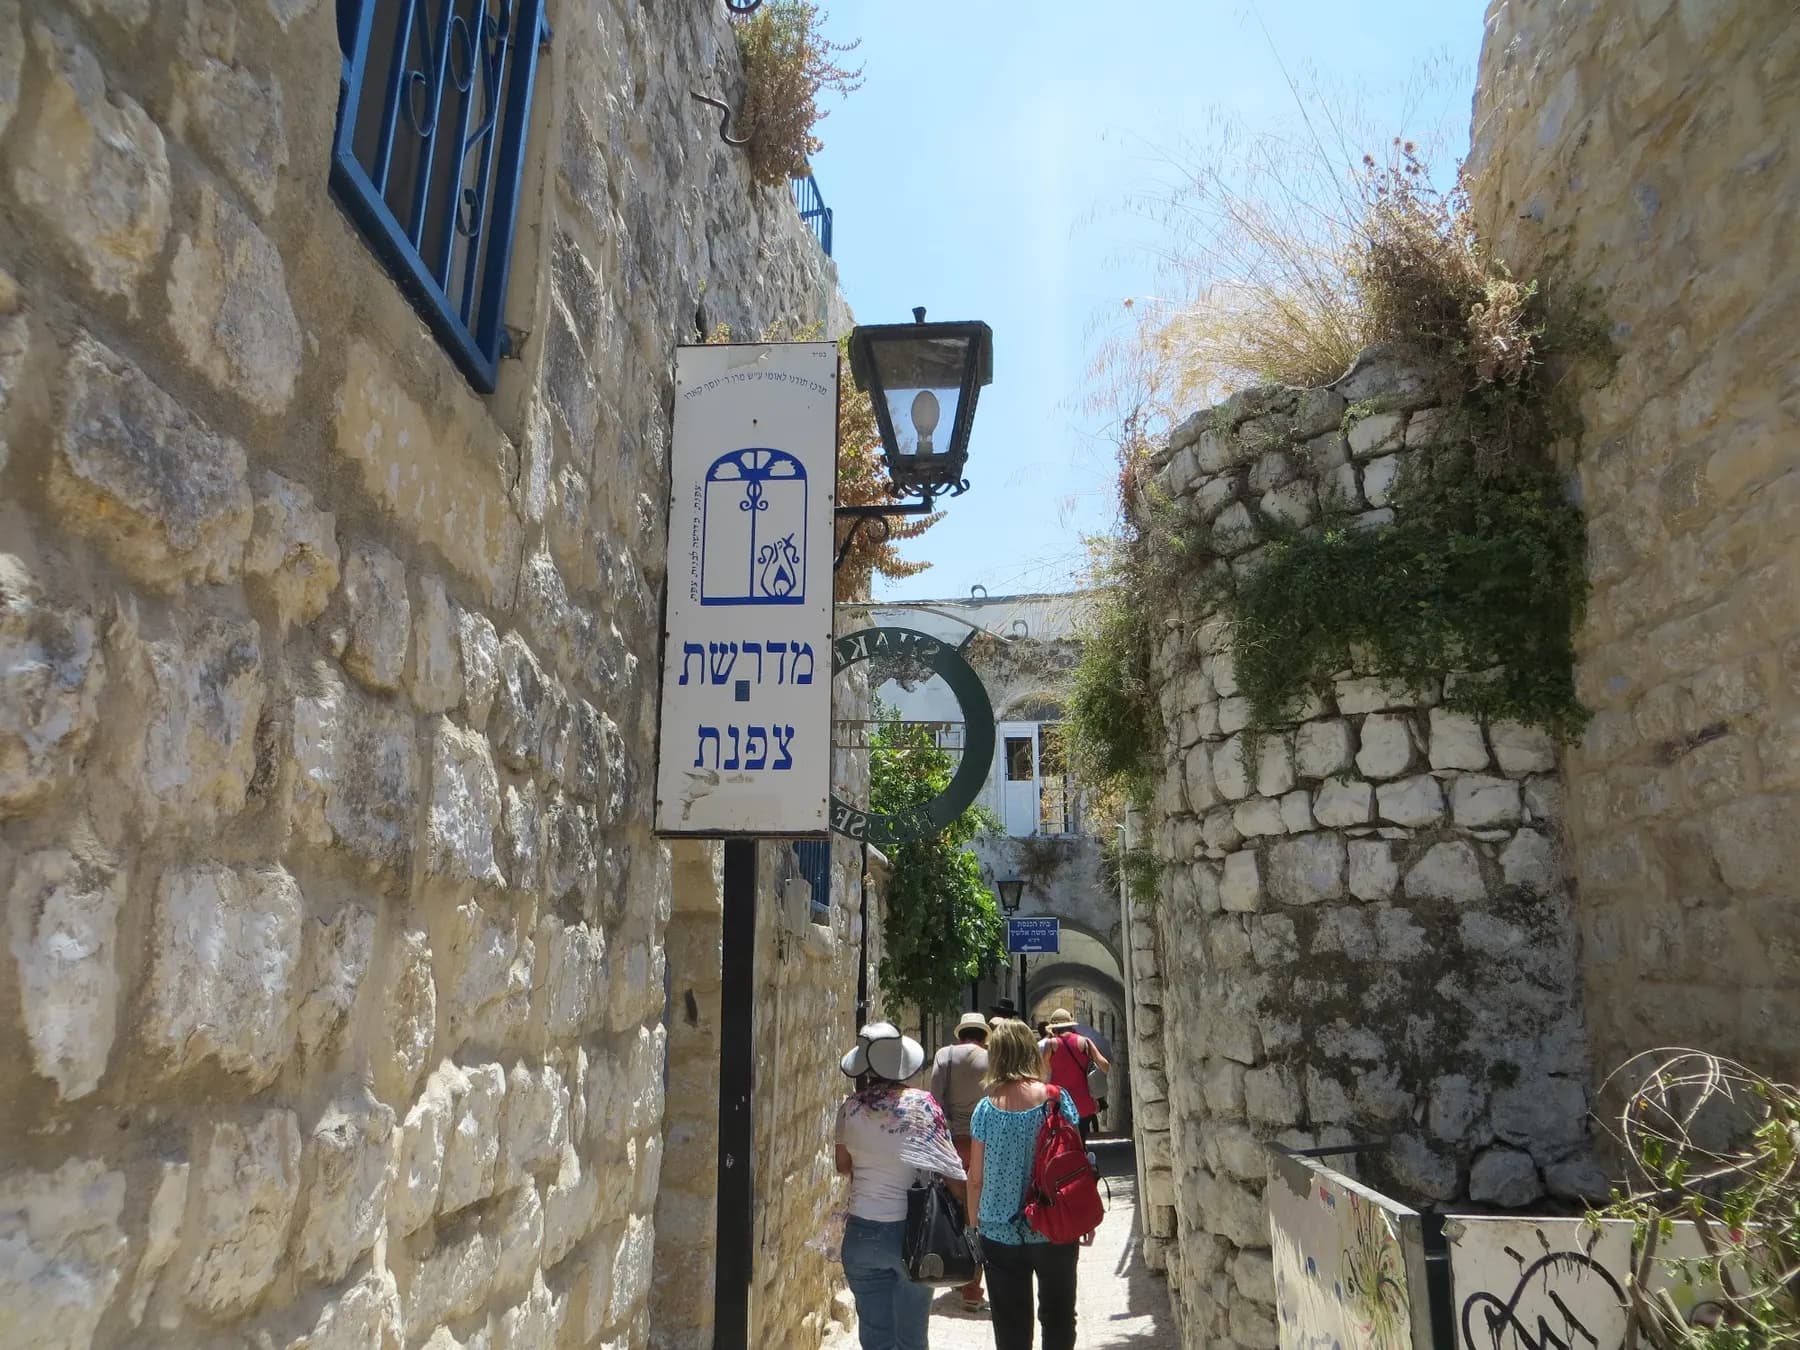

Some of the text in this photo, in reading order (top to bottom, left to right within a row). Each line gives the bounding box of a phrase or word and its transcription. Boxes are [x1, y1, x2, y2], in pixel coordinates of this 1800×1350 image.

[731, 373, 746, 384] מרן
[764, 371, 787, 383] לאומי
[788, 374, 809, 388] תורני
[704, 378, 721, 392] יוסף
[809, 381, 828, 396] מרכז
[683, 386, 703, 400] קארו
[678, 640, 815, 686] מדרשת
[693, 724, 795, 770] צפנת
